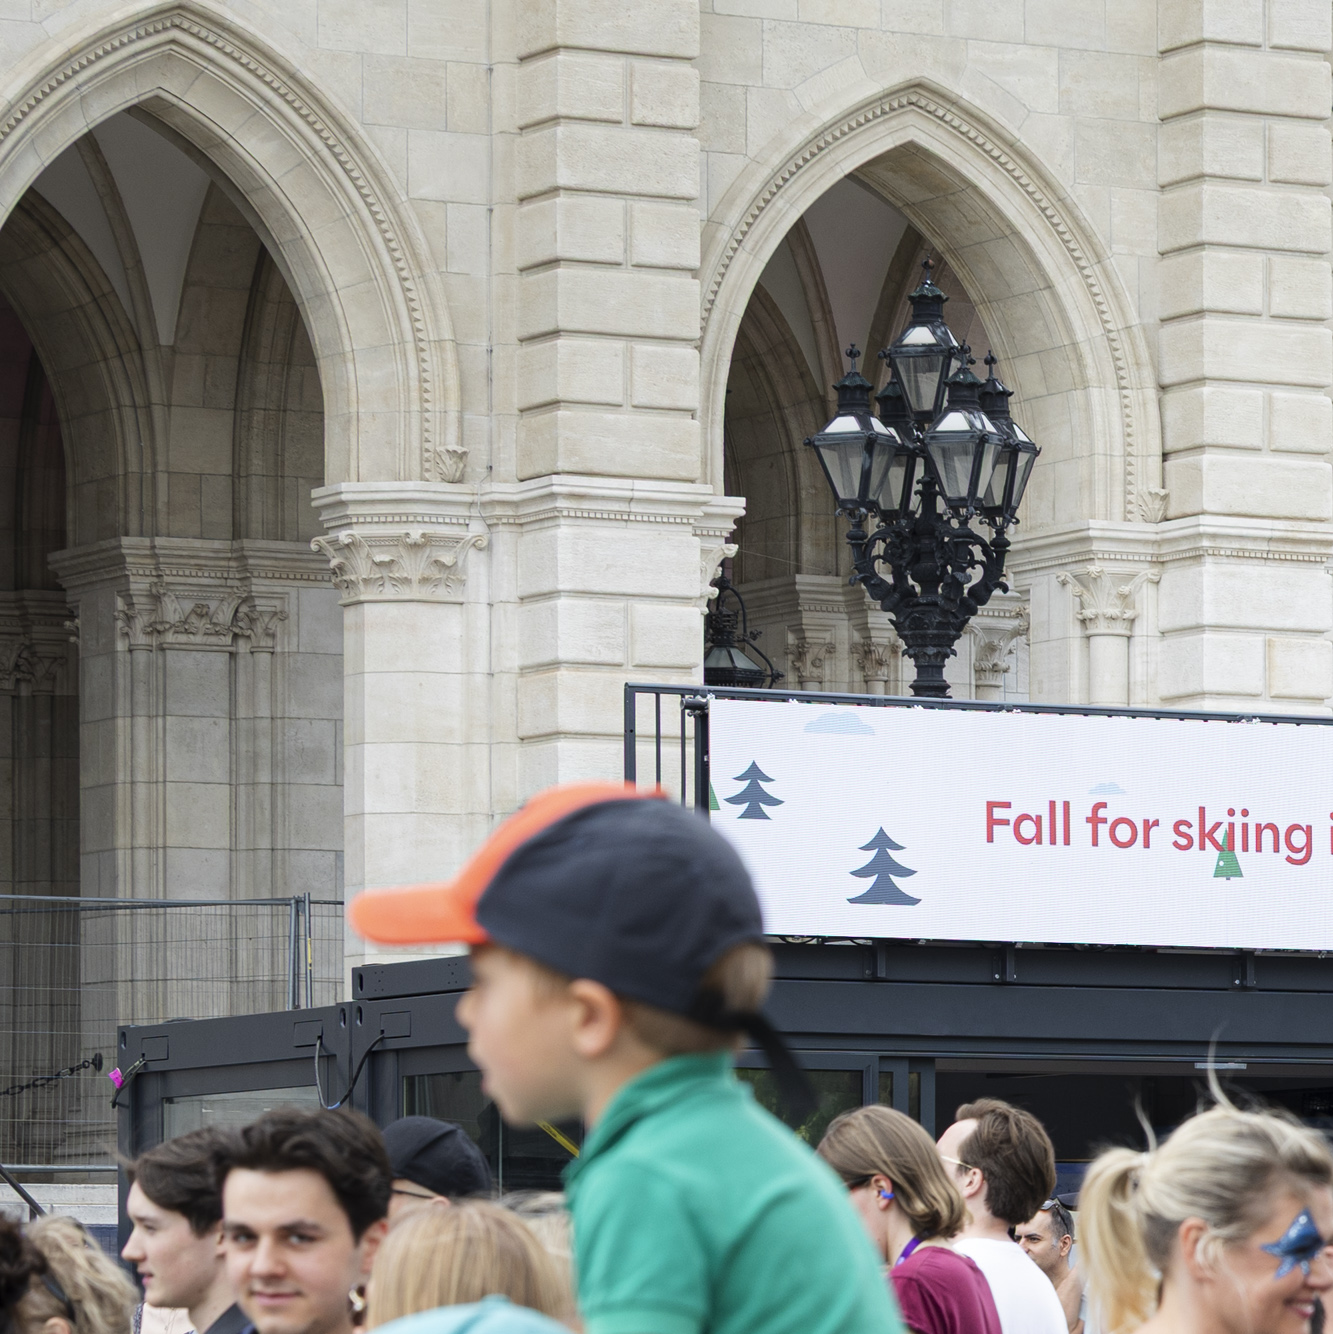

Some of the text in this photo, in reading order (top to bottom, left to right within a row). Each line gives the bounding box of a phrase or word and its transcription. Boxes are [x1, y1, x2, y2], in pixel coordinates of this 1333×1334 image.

[987, 800, 1069, 845] Fall
[1087, 802, 1158, 847] for
[1173, 806, 1311, 865] skiing
